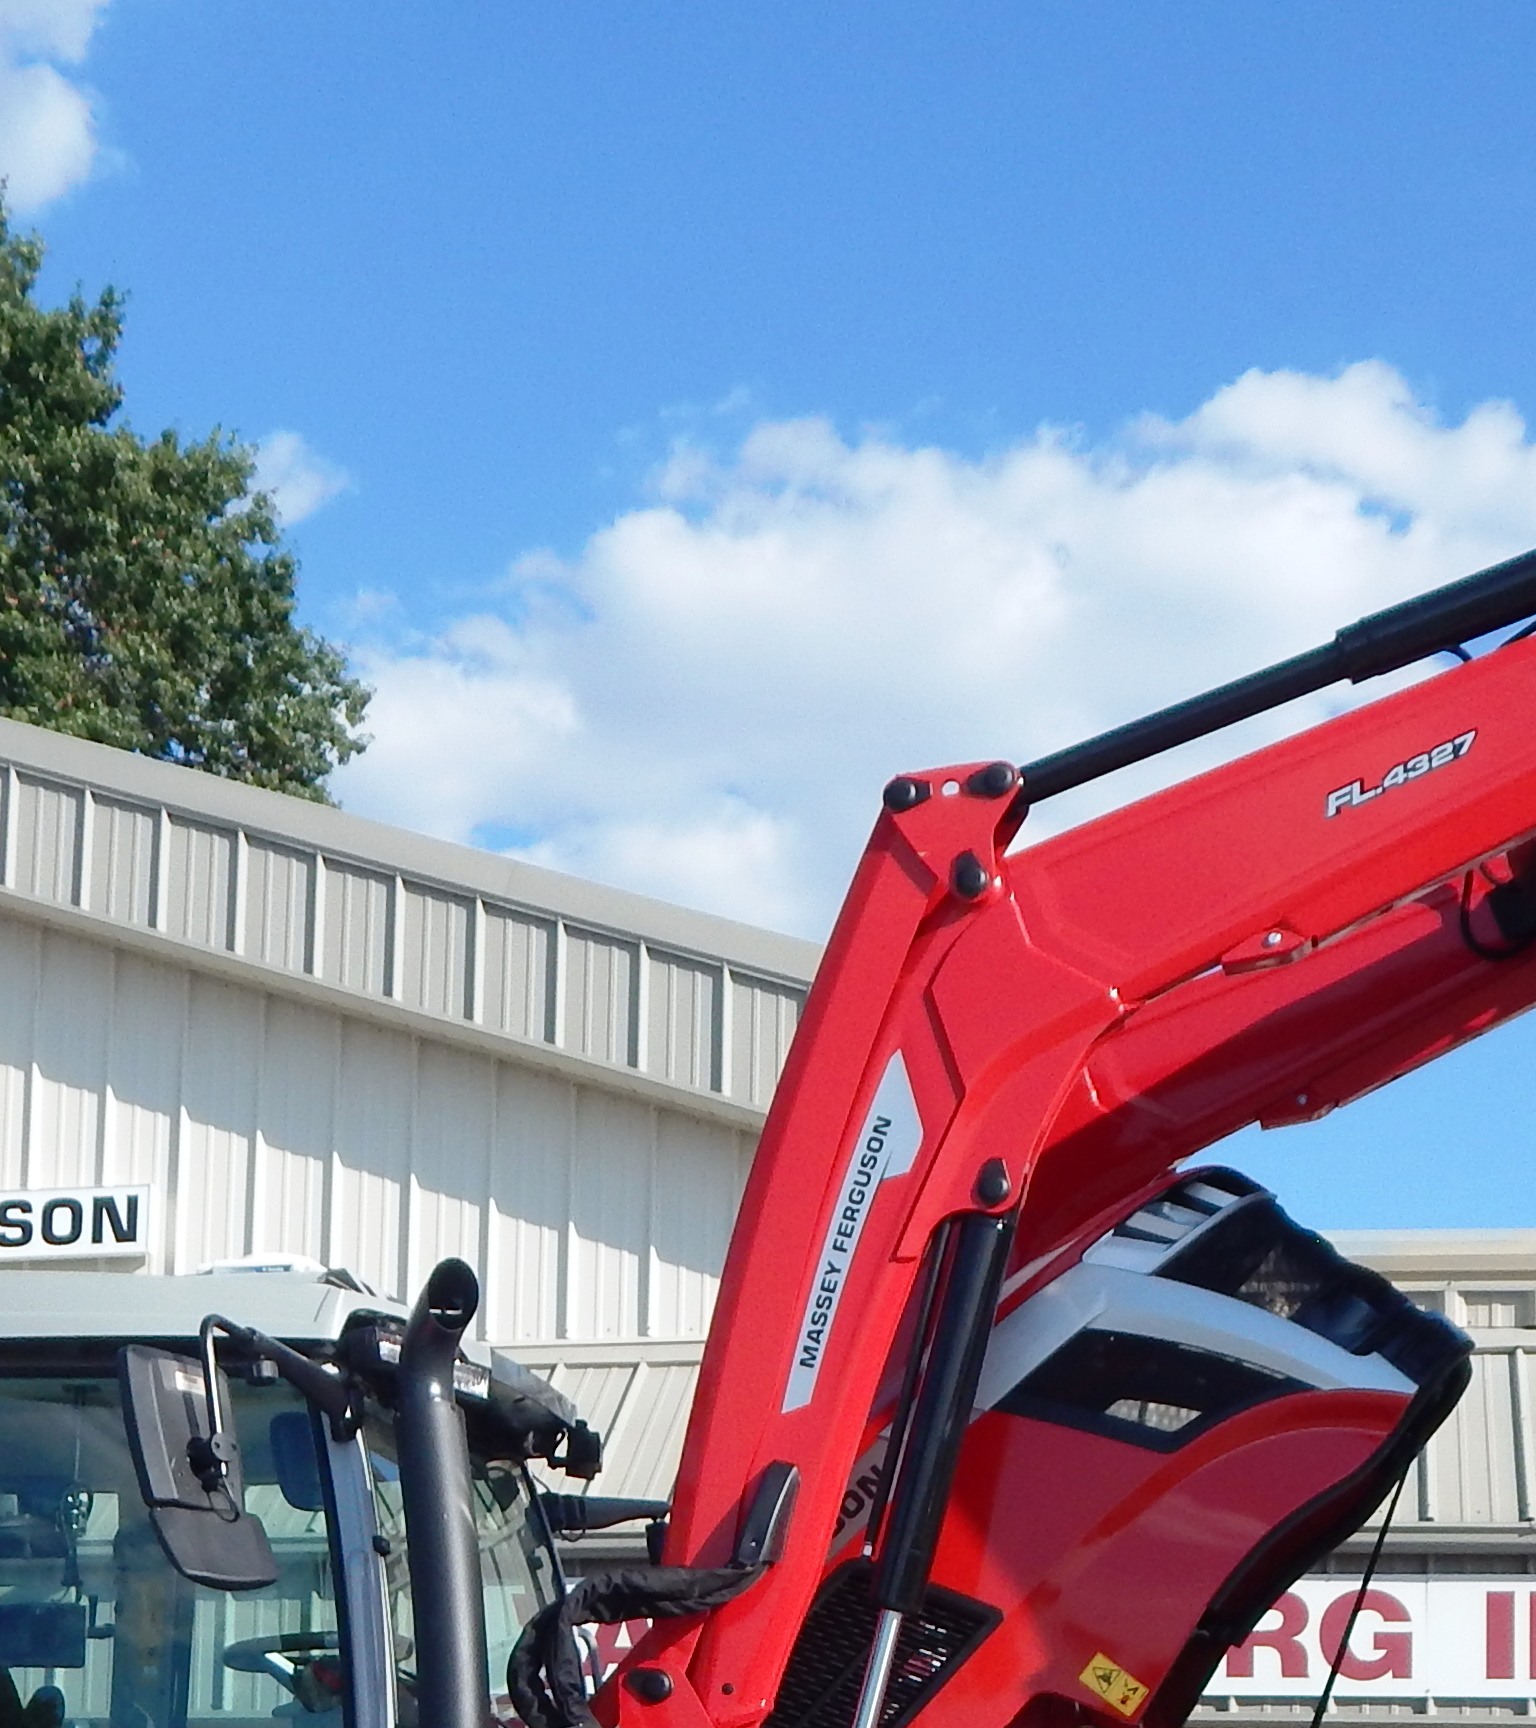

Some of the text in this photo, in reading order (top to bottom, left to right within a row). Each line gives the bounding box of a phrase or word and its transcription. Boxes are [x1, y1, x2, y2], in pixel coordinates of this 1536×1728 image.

[1325, 729, 1477, 818] FL.4327
[799, 1114, 892, 1369] MASSEY FERGUSON
